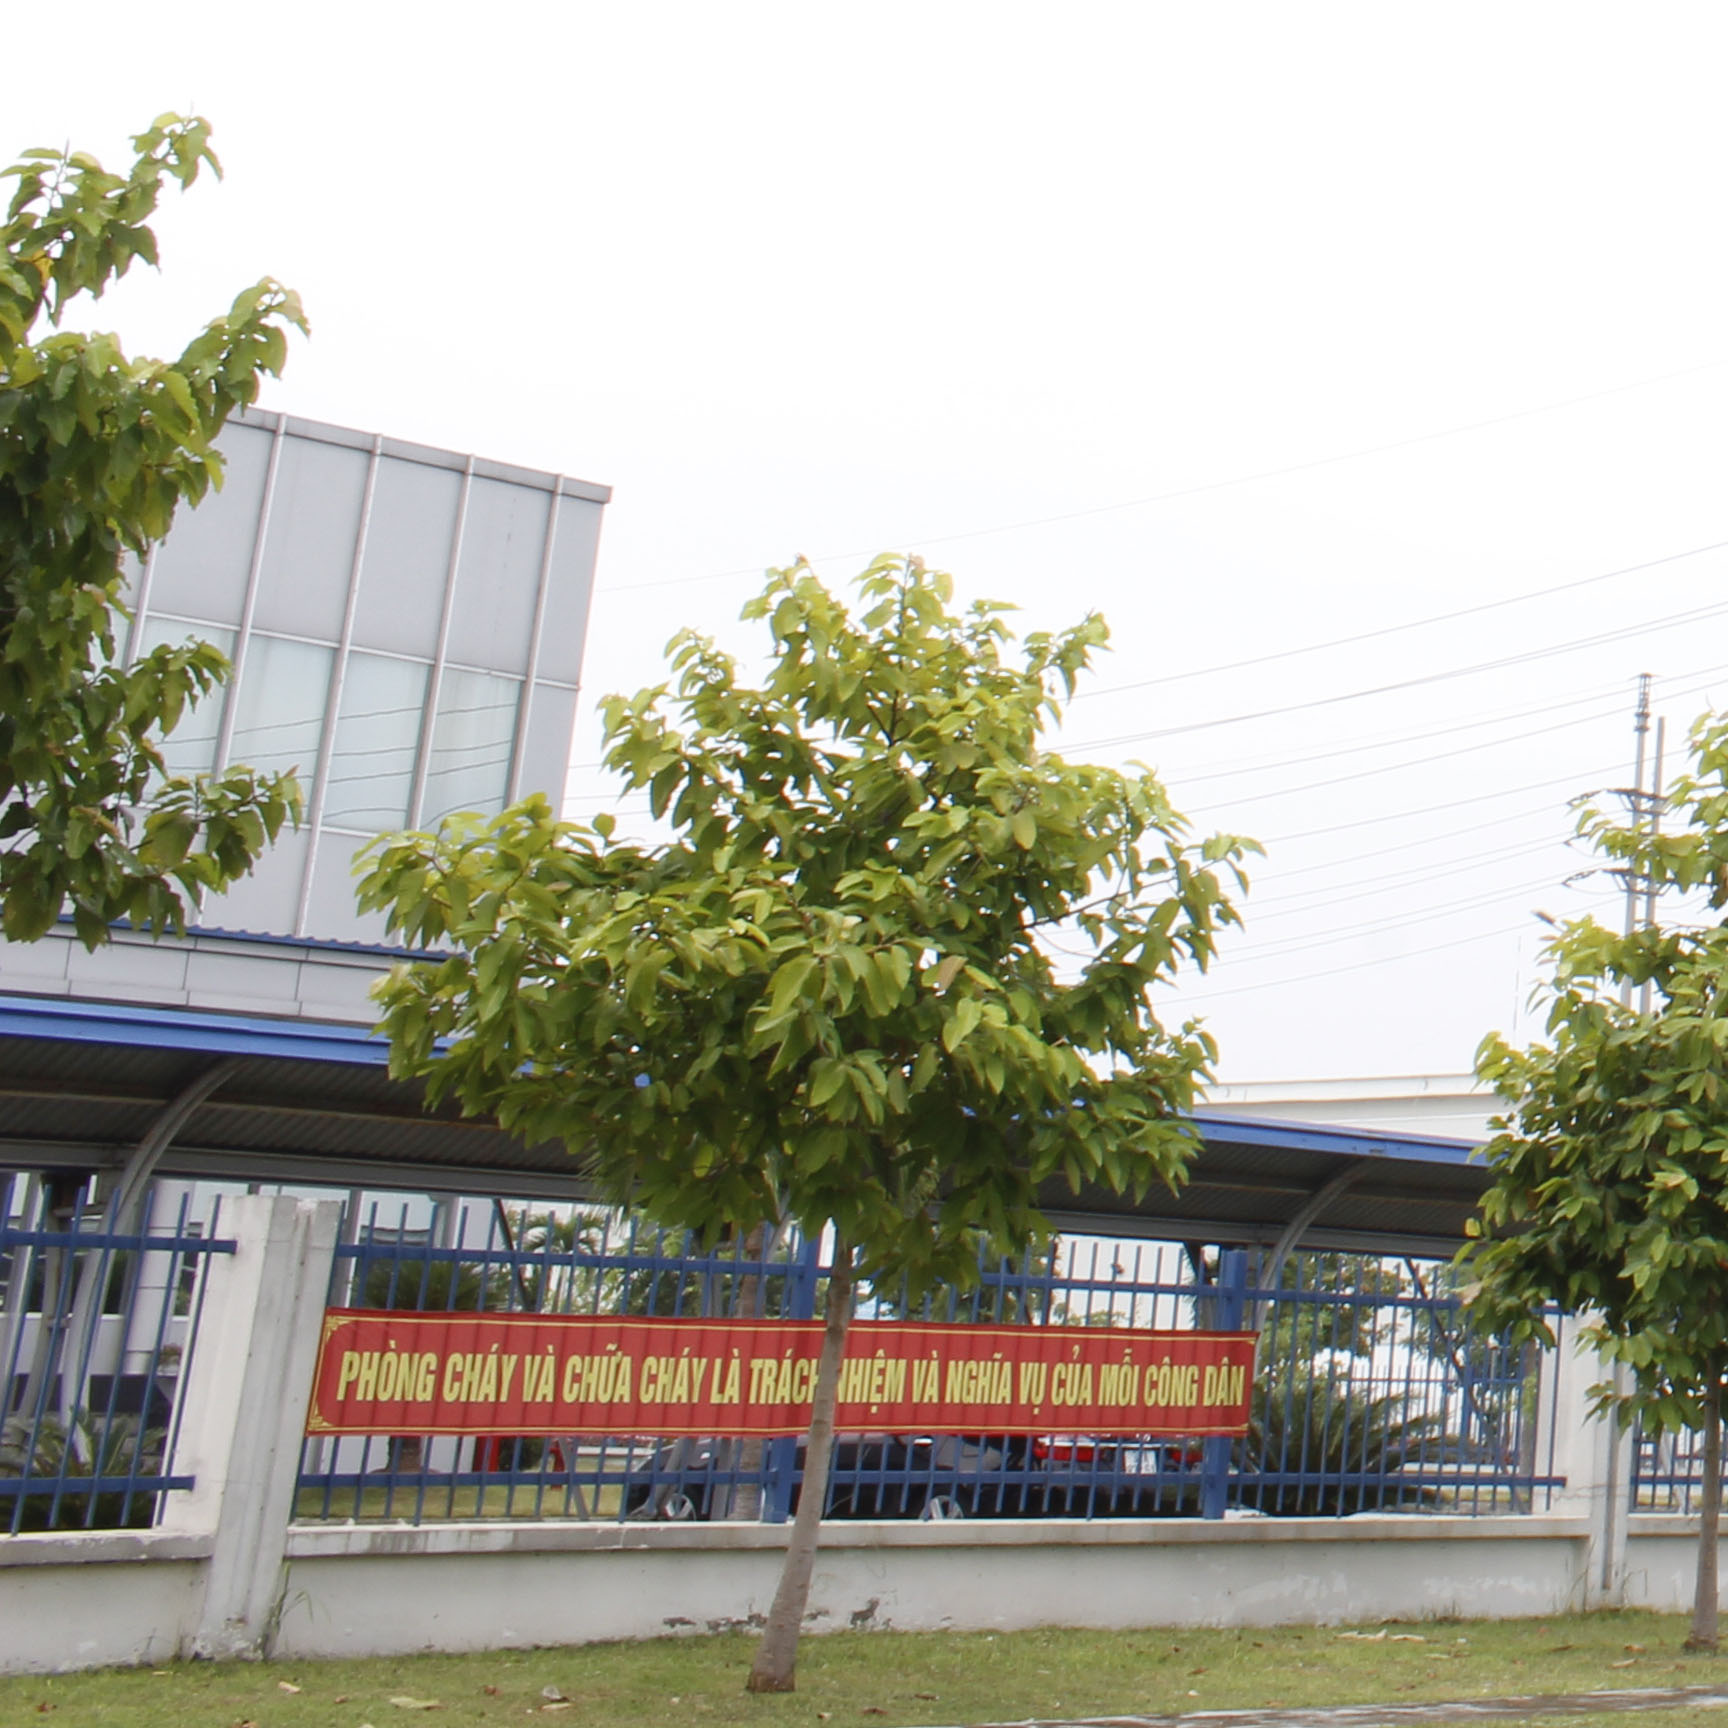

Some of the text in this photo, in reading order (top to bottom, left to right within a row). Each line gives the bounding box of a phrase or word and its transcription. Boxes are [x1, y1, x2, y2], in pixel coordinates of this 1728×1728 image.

[336, 1339, 438, 1402] PHÒNG
[442, 1343, 518, 1403] CHÁY
[522, 1344, 556, 1403] VÀ
[562, 1343, 632, 1404] CHỮA
[639, 1346, 708, 1404] CHÁY
[710, 1347, 741, 1404] LÀ
[912, 1349, 940, 1404] VÀ
[945, 1352, 1012, 1405] NGHĨA
[1019, 1361, 1048, 1415] VỤ
[1051, 1344, 1093, 1406] CỦA
[1098, 1348, 1140, 1407] MỖI
[1144, 1356, 1200, 1407] CÔNG
[1203, 1356, 1246, 1407] DÂN
